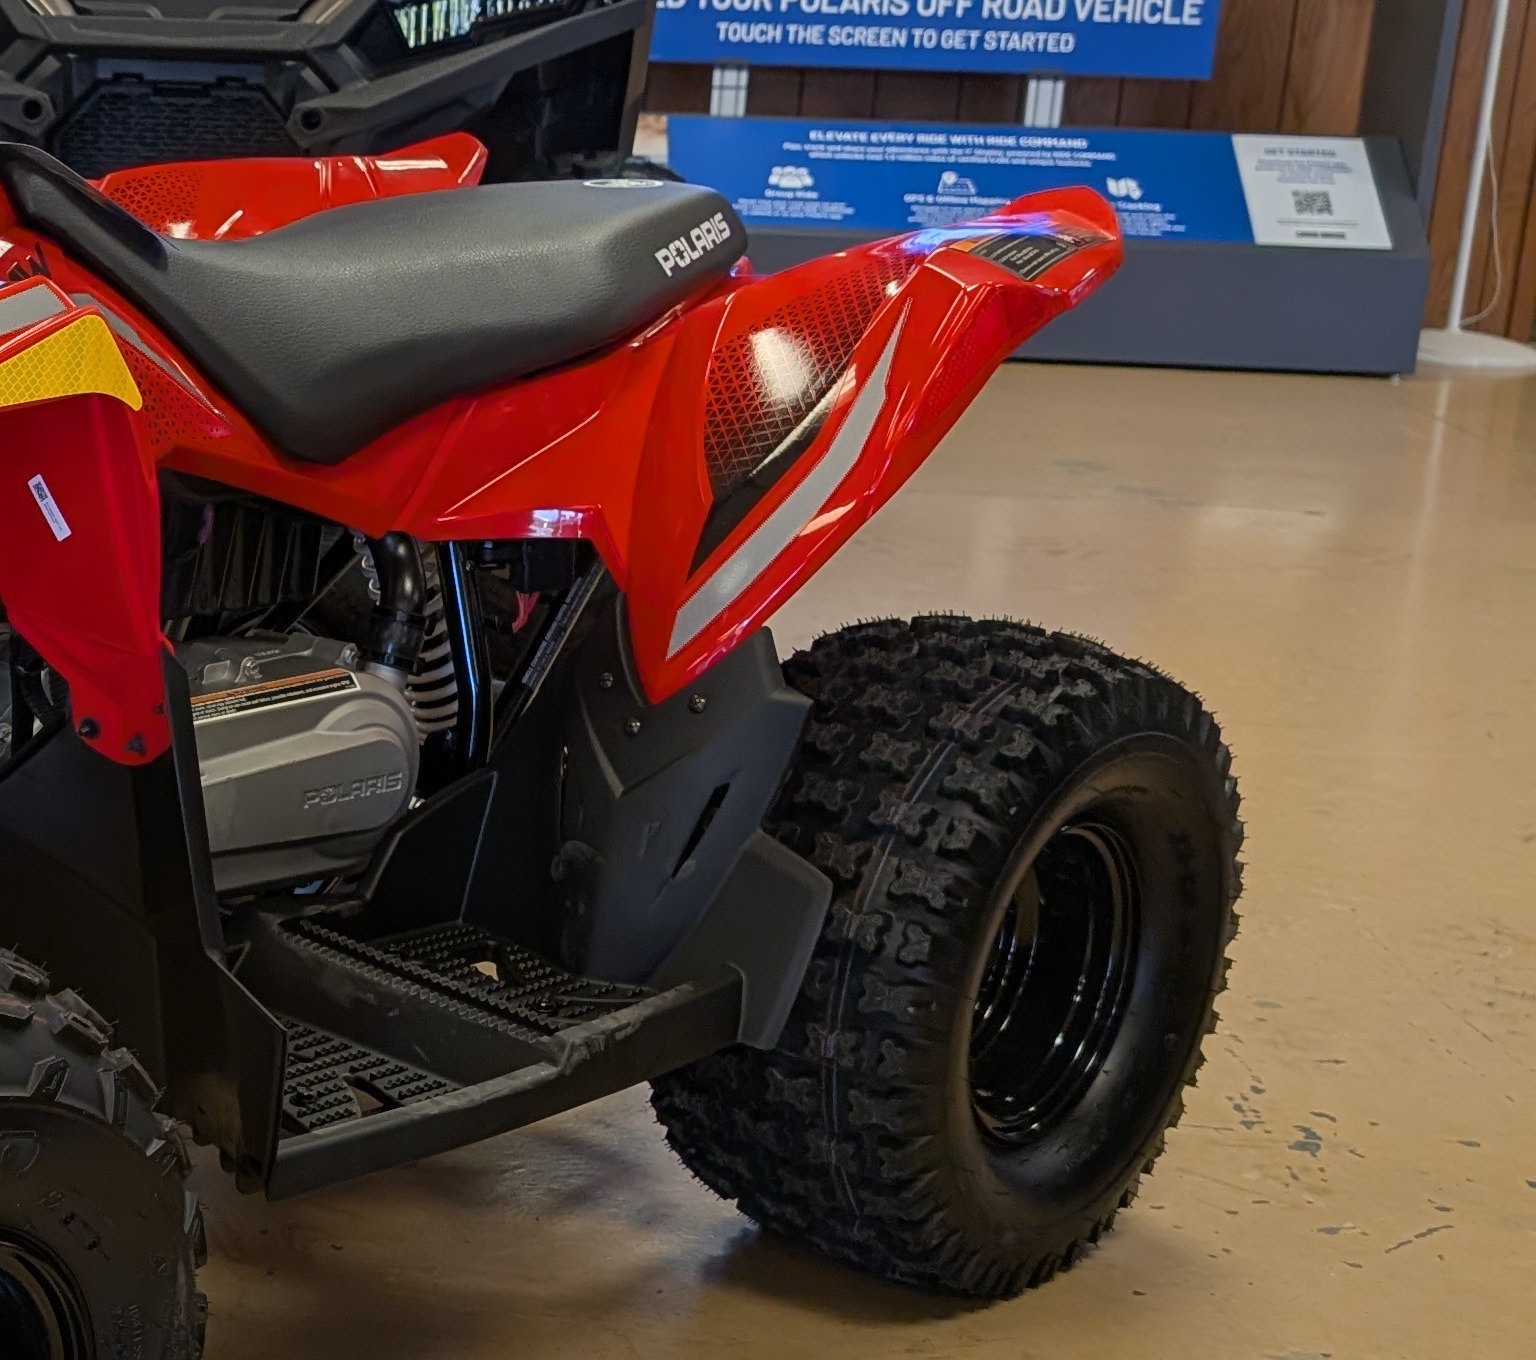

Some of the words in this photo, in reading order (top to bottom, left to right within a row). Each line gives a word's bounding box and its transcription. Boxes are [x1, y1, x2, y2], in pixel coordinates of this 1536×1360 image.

[716, 21, 782, 44] TOUCH
[786, 24, 825, 44] THE
[828, 25, 907, 48] SCREEN
[911, 27, 937, 49] TO
[941, 29, 981, 50] GET
[983, 30, 1076, 54] STARTED
[809, 130, 868, 142] ELEVATE
[870, 131, 914, 143] EVERY
[916, 132, 947, 144] RIDE
[950, 133, 984, 146] WITH
[986, 134, 1016, 147] RIDE
[1019, 136, 1088, 149] COMMAND
[654, 211, 731, 277] POLARIS
[303, 770, 403, 811] POLARIS
